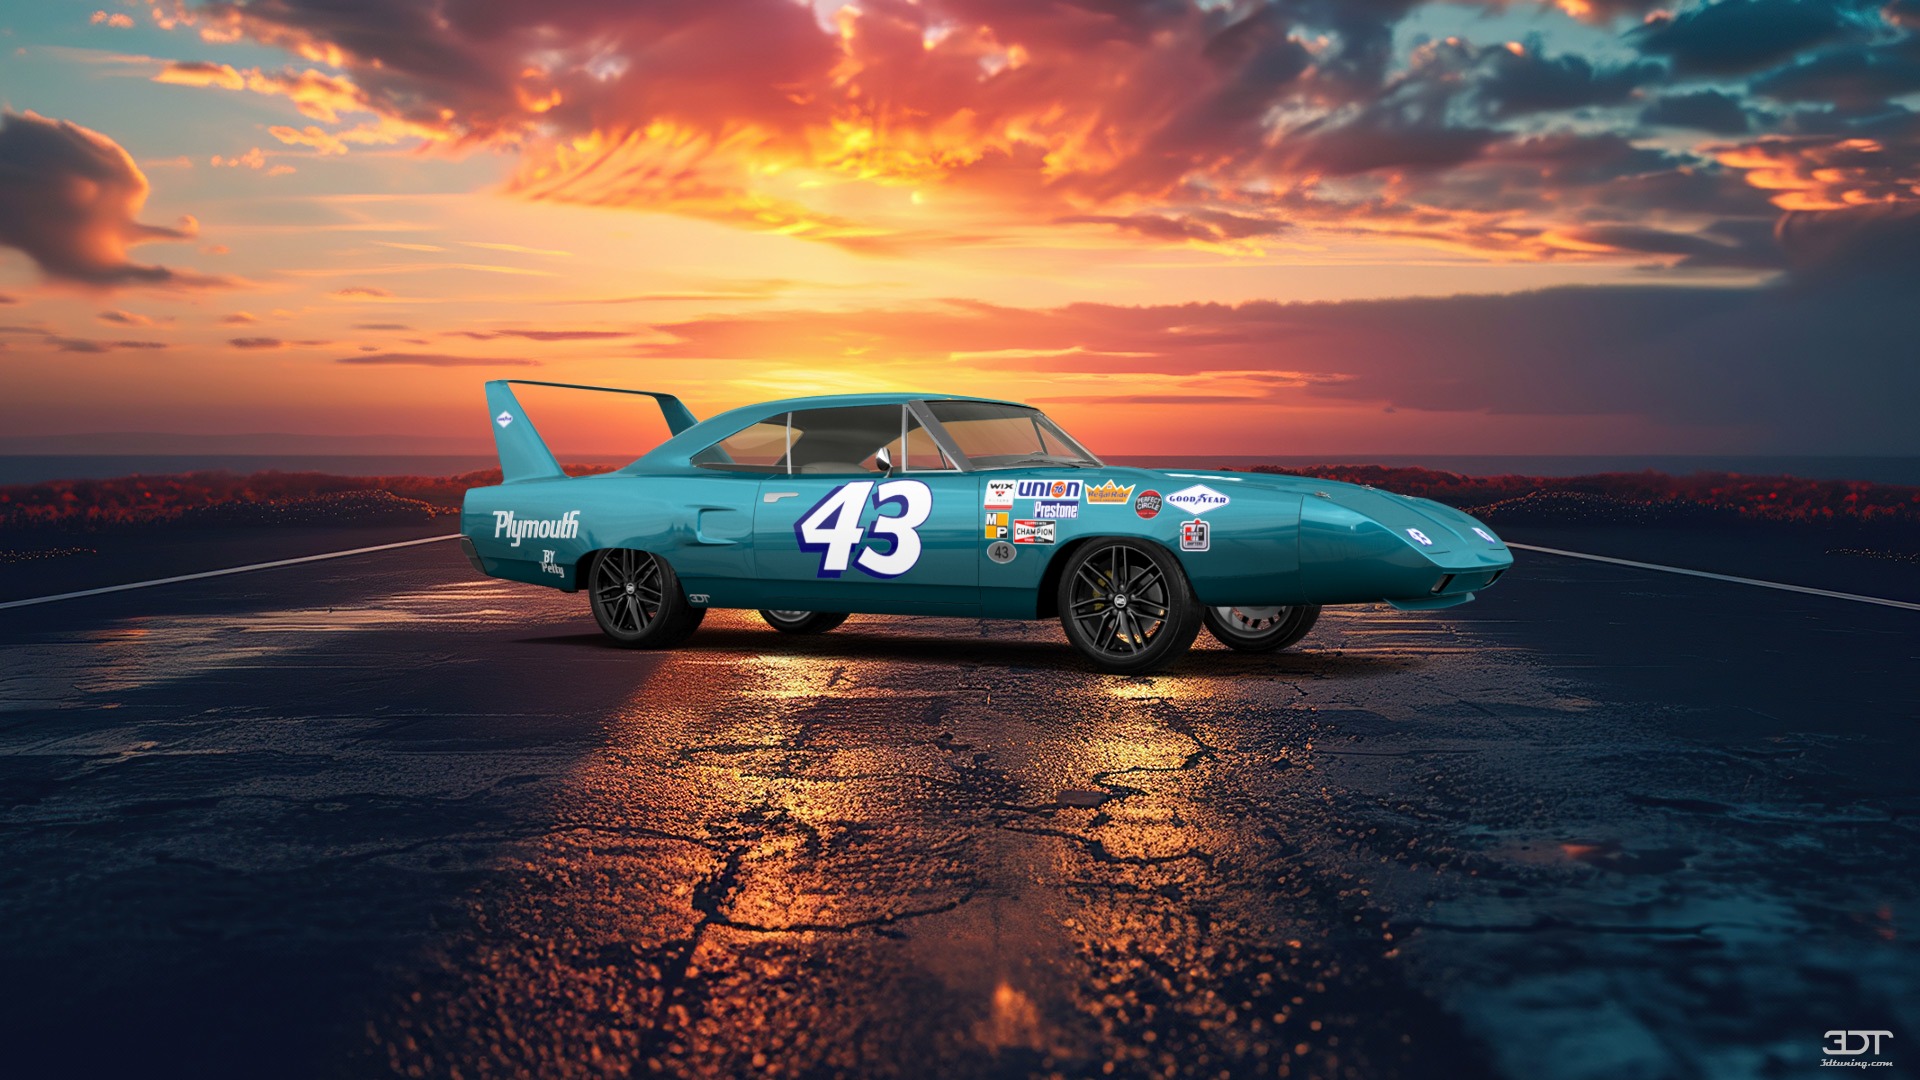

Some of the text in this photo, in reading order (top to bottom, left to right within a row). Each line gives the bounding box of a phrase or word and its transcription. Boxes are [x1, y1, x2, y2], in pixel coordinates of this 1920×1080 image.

[1034, 501, 1078, 518] Prestone
[1137, 503, 1160, 511] CIRCLE
[493, 510, 580, 547] Plymouth
[793, 478, 933, 579] 43
[1016, 528, 1053, 536] CHAMPION
[542, 549, 555, 563] BY
[994, 546, 1009, 559] 43
